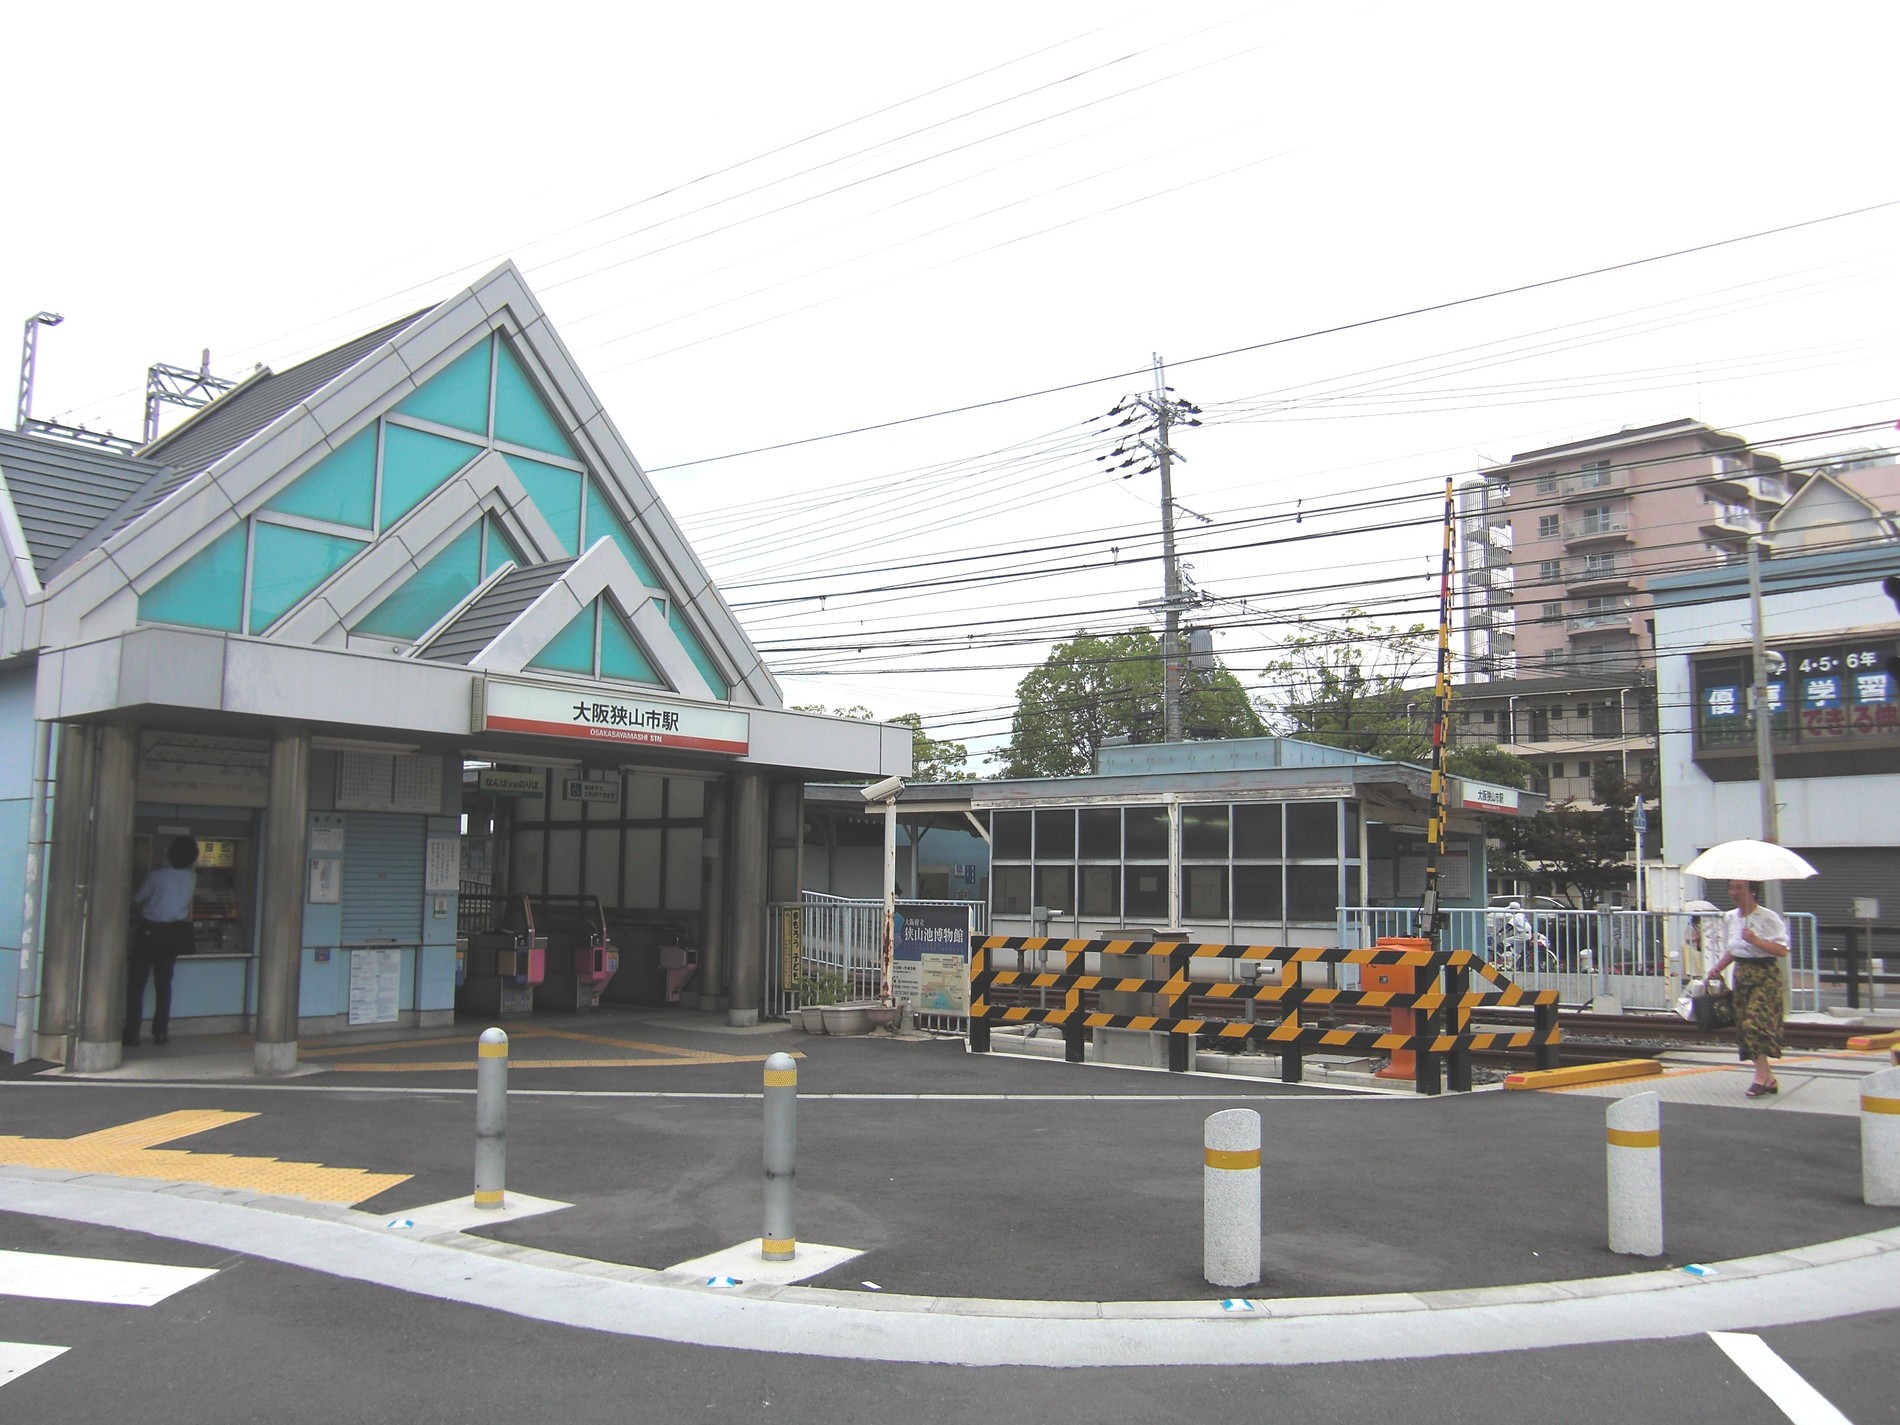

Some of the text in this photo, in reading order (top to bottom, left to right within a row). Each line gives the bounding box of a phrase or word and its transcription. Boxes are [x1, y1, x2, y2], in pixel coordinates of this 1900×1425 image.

[572, 701, 680, 732] 大阪狭山市駅
[589, 728, 649, 742] OSAKASAYAMASHI
[904, 926, 964, 943] 狭山池博物館
